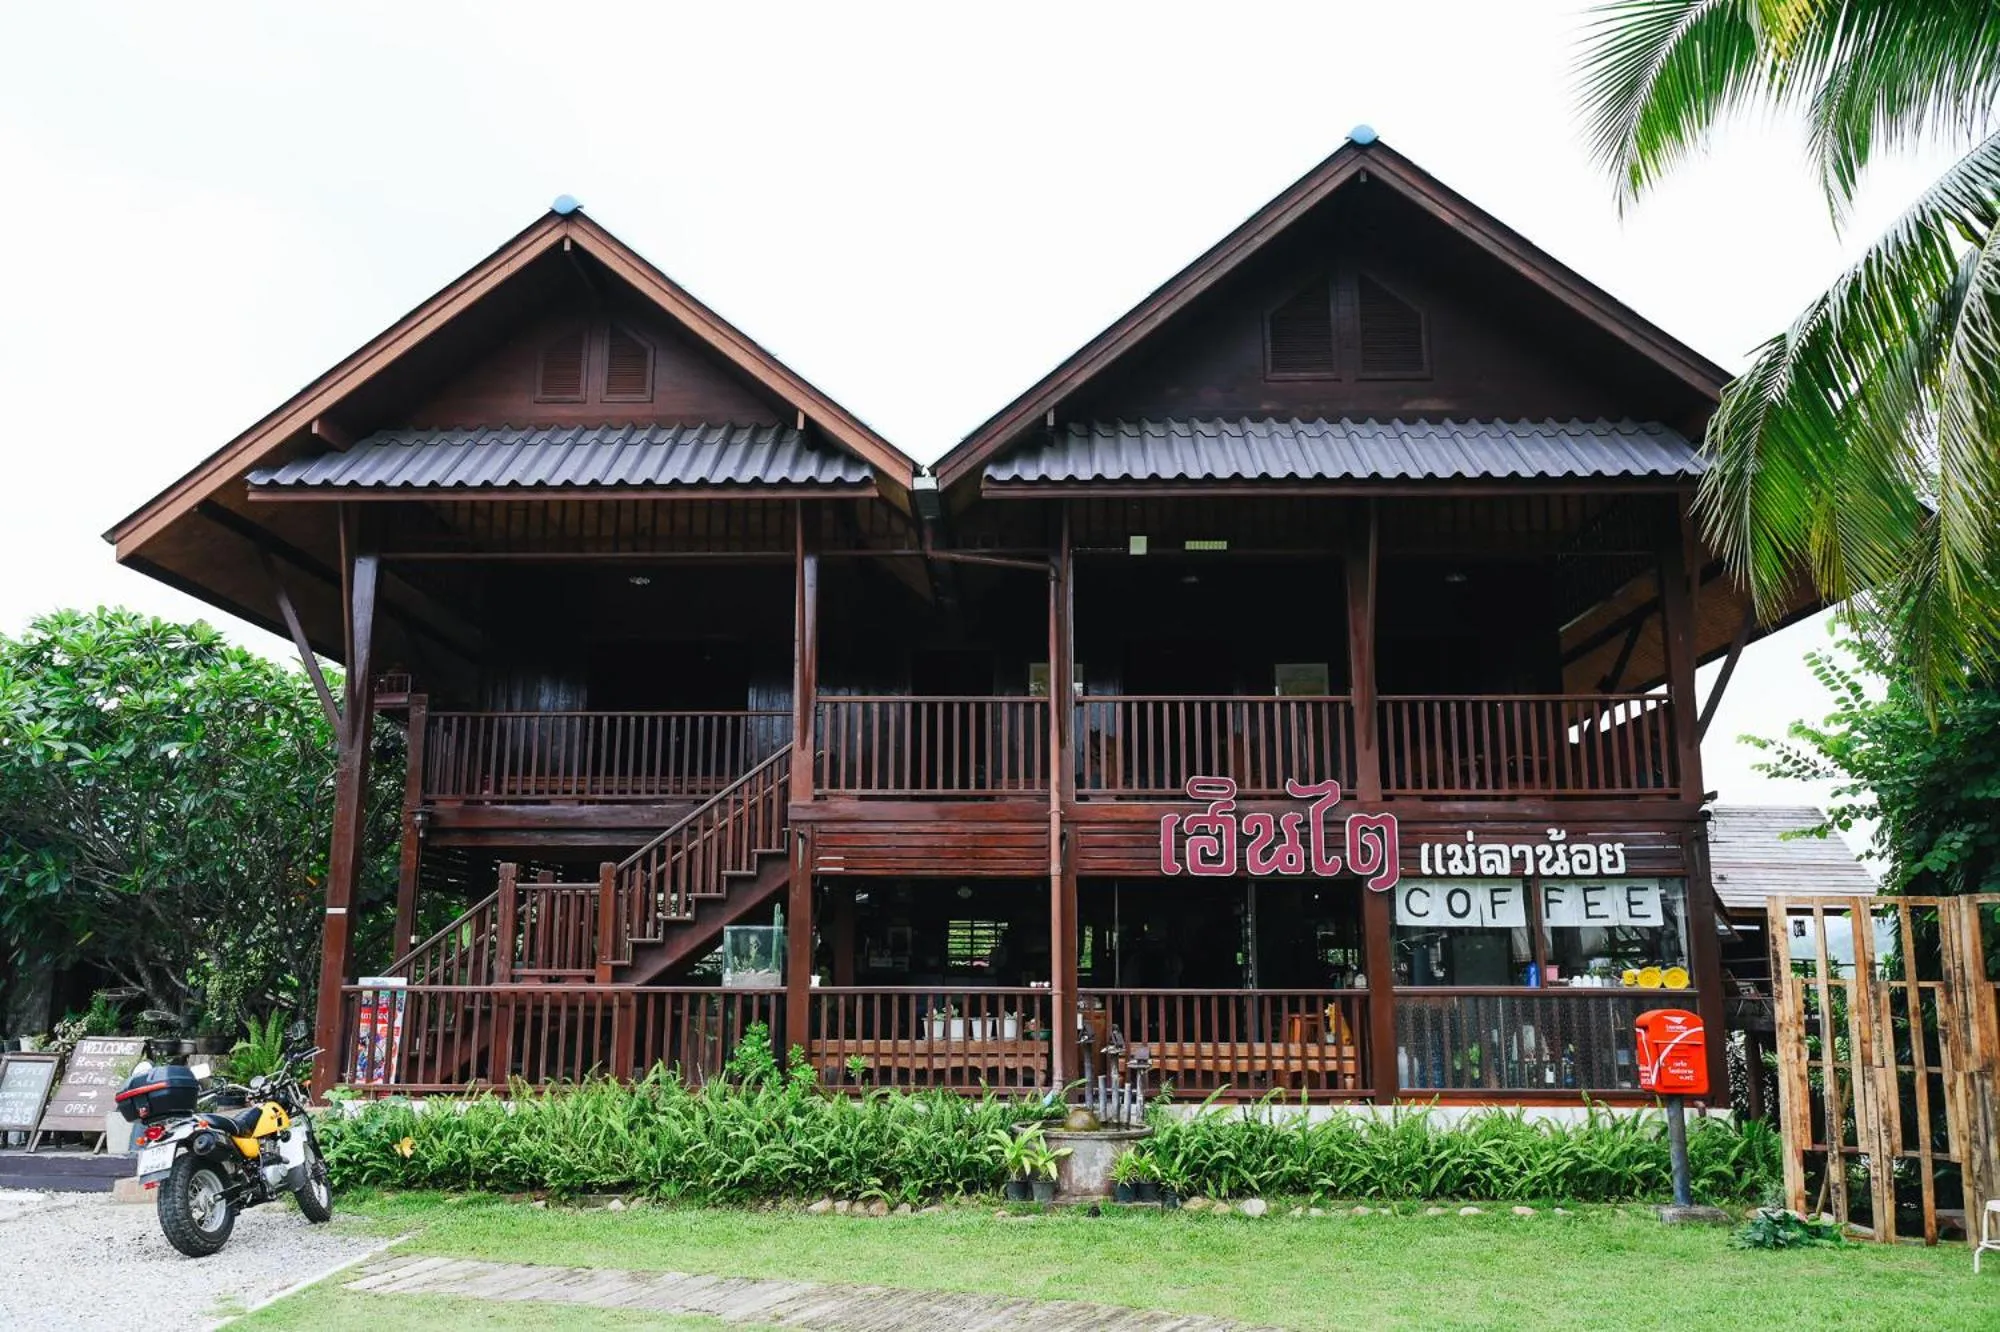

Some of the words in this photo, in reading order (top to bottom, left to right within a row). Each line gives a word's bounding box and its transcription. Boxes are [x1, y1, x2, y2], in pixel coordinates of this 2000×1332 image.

[1420, 828, 1627, 876] แม่ลาน้อย
[82, 1041, 138, 1055] WELCOME
[64, 1103, 97, 1114] OPEN
